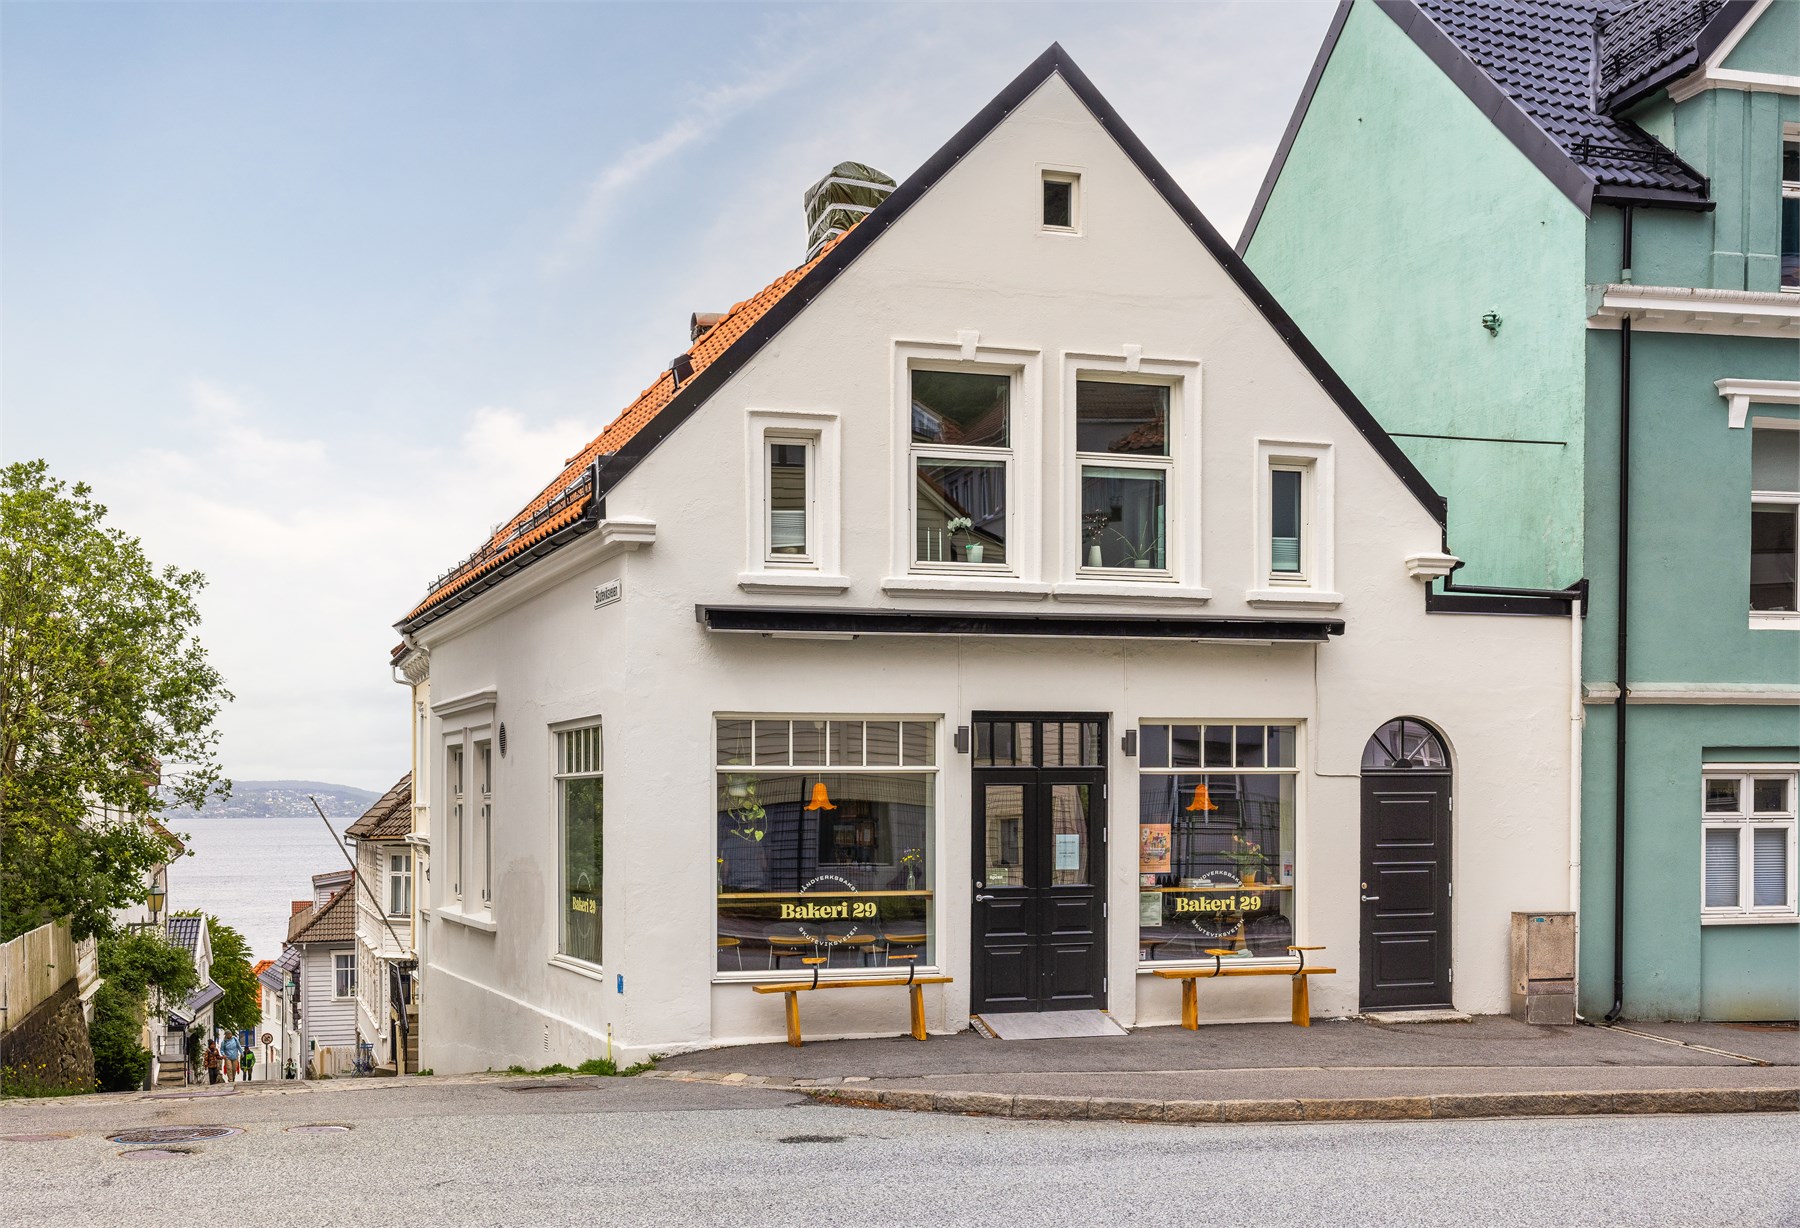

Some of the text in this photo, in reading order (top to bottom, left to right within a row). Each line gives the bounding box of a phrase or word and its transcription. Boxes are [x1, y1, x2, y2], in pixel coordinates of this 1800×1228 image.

[572, 896, 589, 913] Bakeri
[780, 901, 877, 919] Bakeri 29
[1175, 895, 1236, 912] Bakeri
[1239, 895, 1262, 911] 29
[798, 925, 859, 947] SKUTEVIKSVEIEN
[1191, 918, 1246, 938] SKUTEVIKSVEIEN
